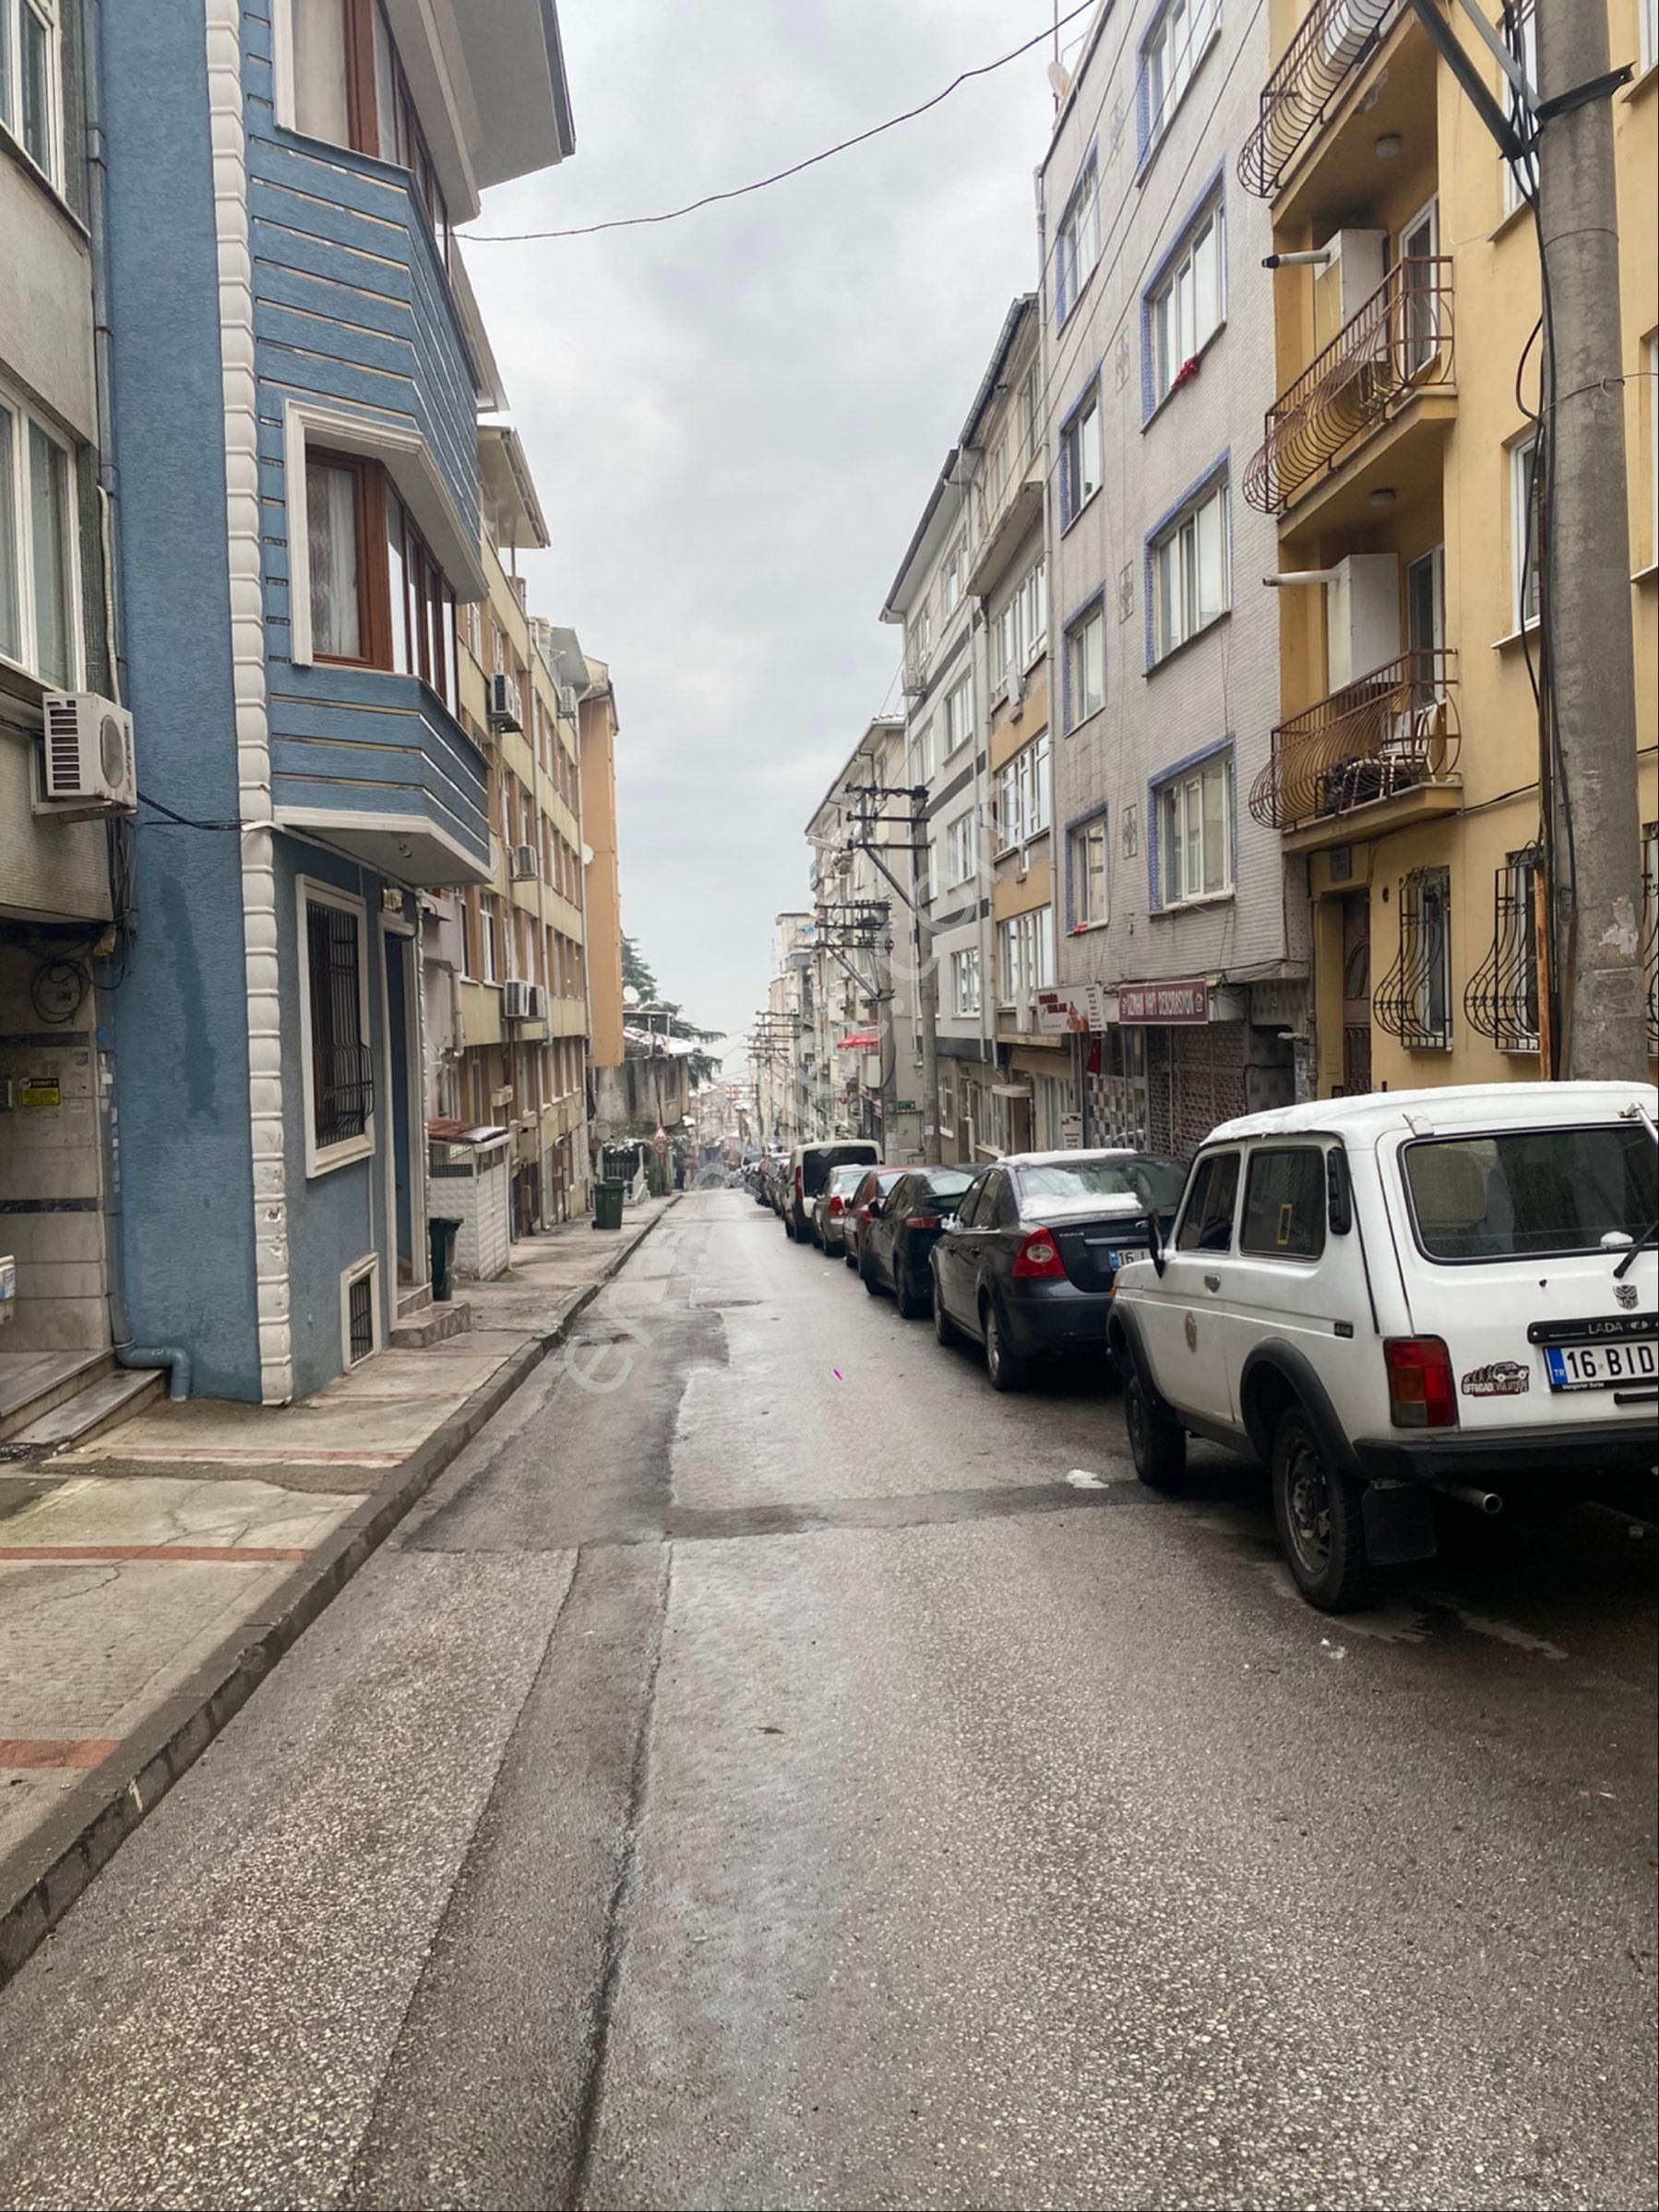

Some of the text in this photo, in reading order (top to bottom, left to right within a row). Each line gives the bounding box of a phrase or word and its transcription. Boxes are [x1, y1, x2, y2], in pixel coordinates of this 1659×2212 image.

[1119, 1251, 1134, 1265] 16
[1588, 1321, 1623, 1334] LADA
[1567, 1346, 1654, 1379] 16 BID
[1554, 1369, 1565, 1377] TR
